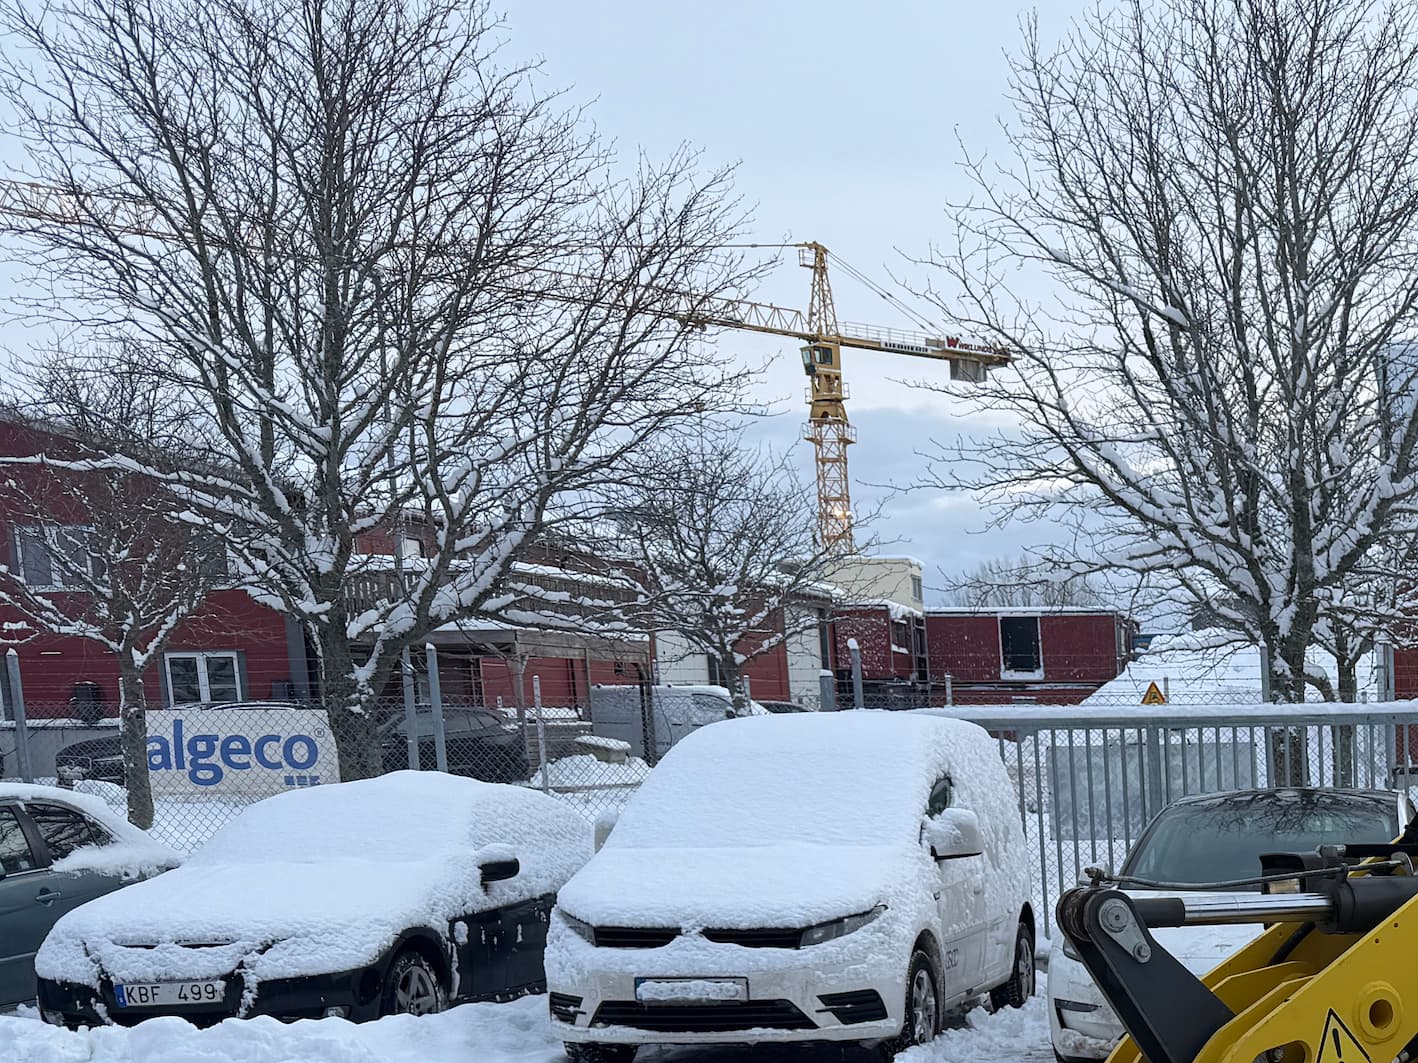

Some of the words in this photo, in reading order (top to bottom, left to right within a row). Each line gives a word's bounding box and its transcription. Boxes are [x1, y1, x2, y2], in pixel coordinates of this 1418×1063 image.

[146, 719, 319, 786] algeco
[126, 985, 160, 1004] KBF
[178, 983, 217, 1001] 499
